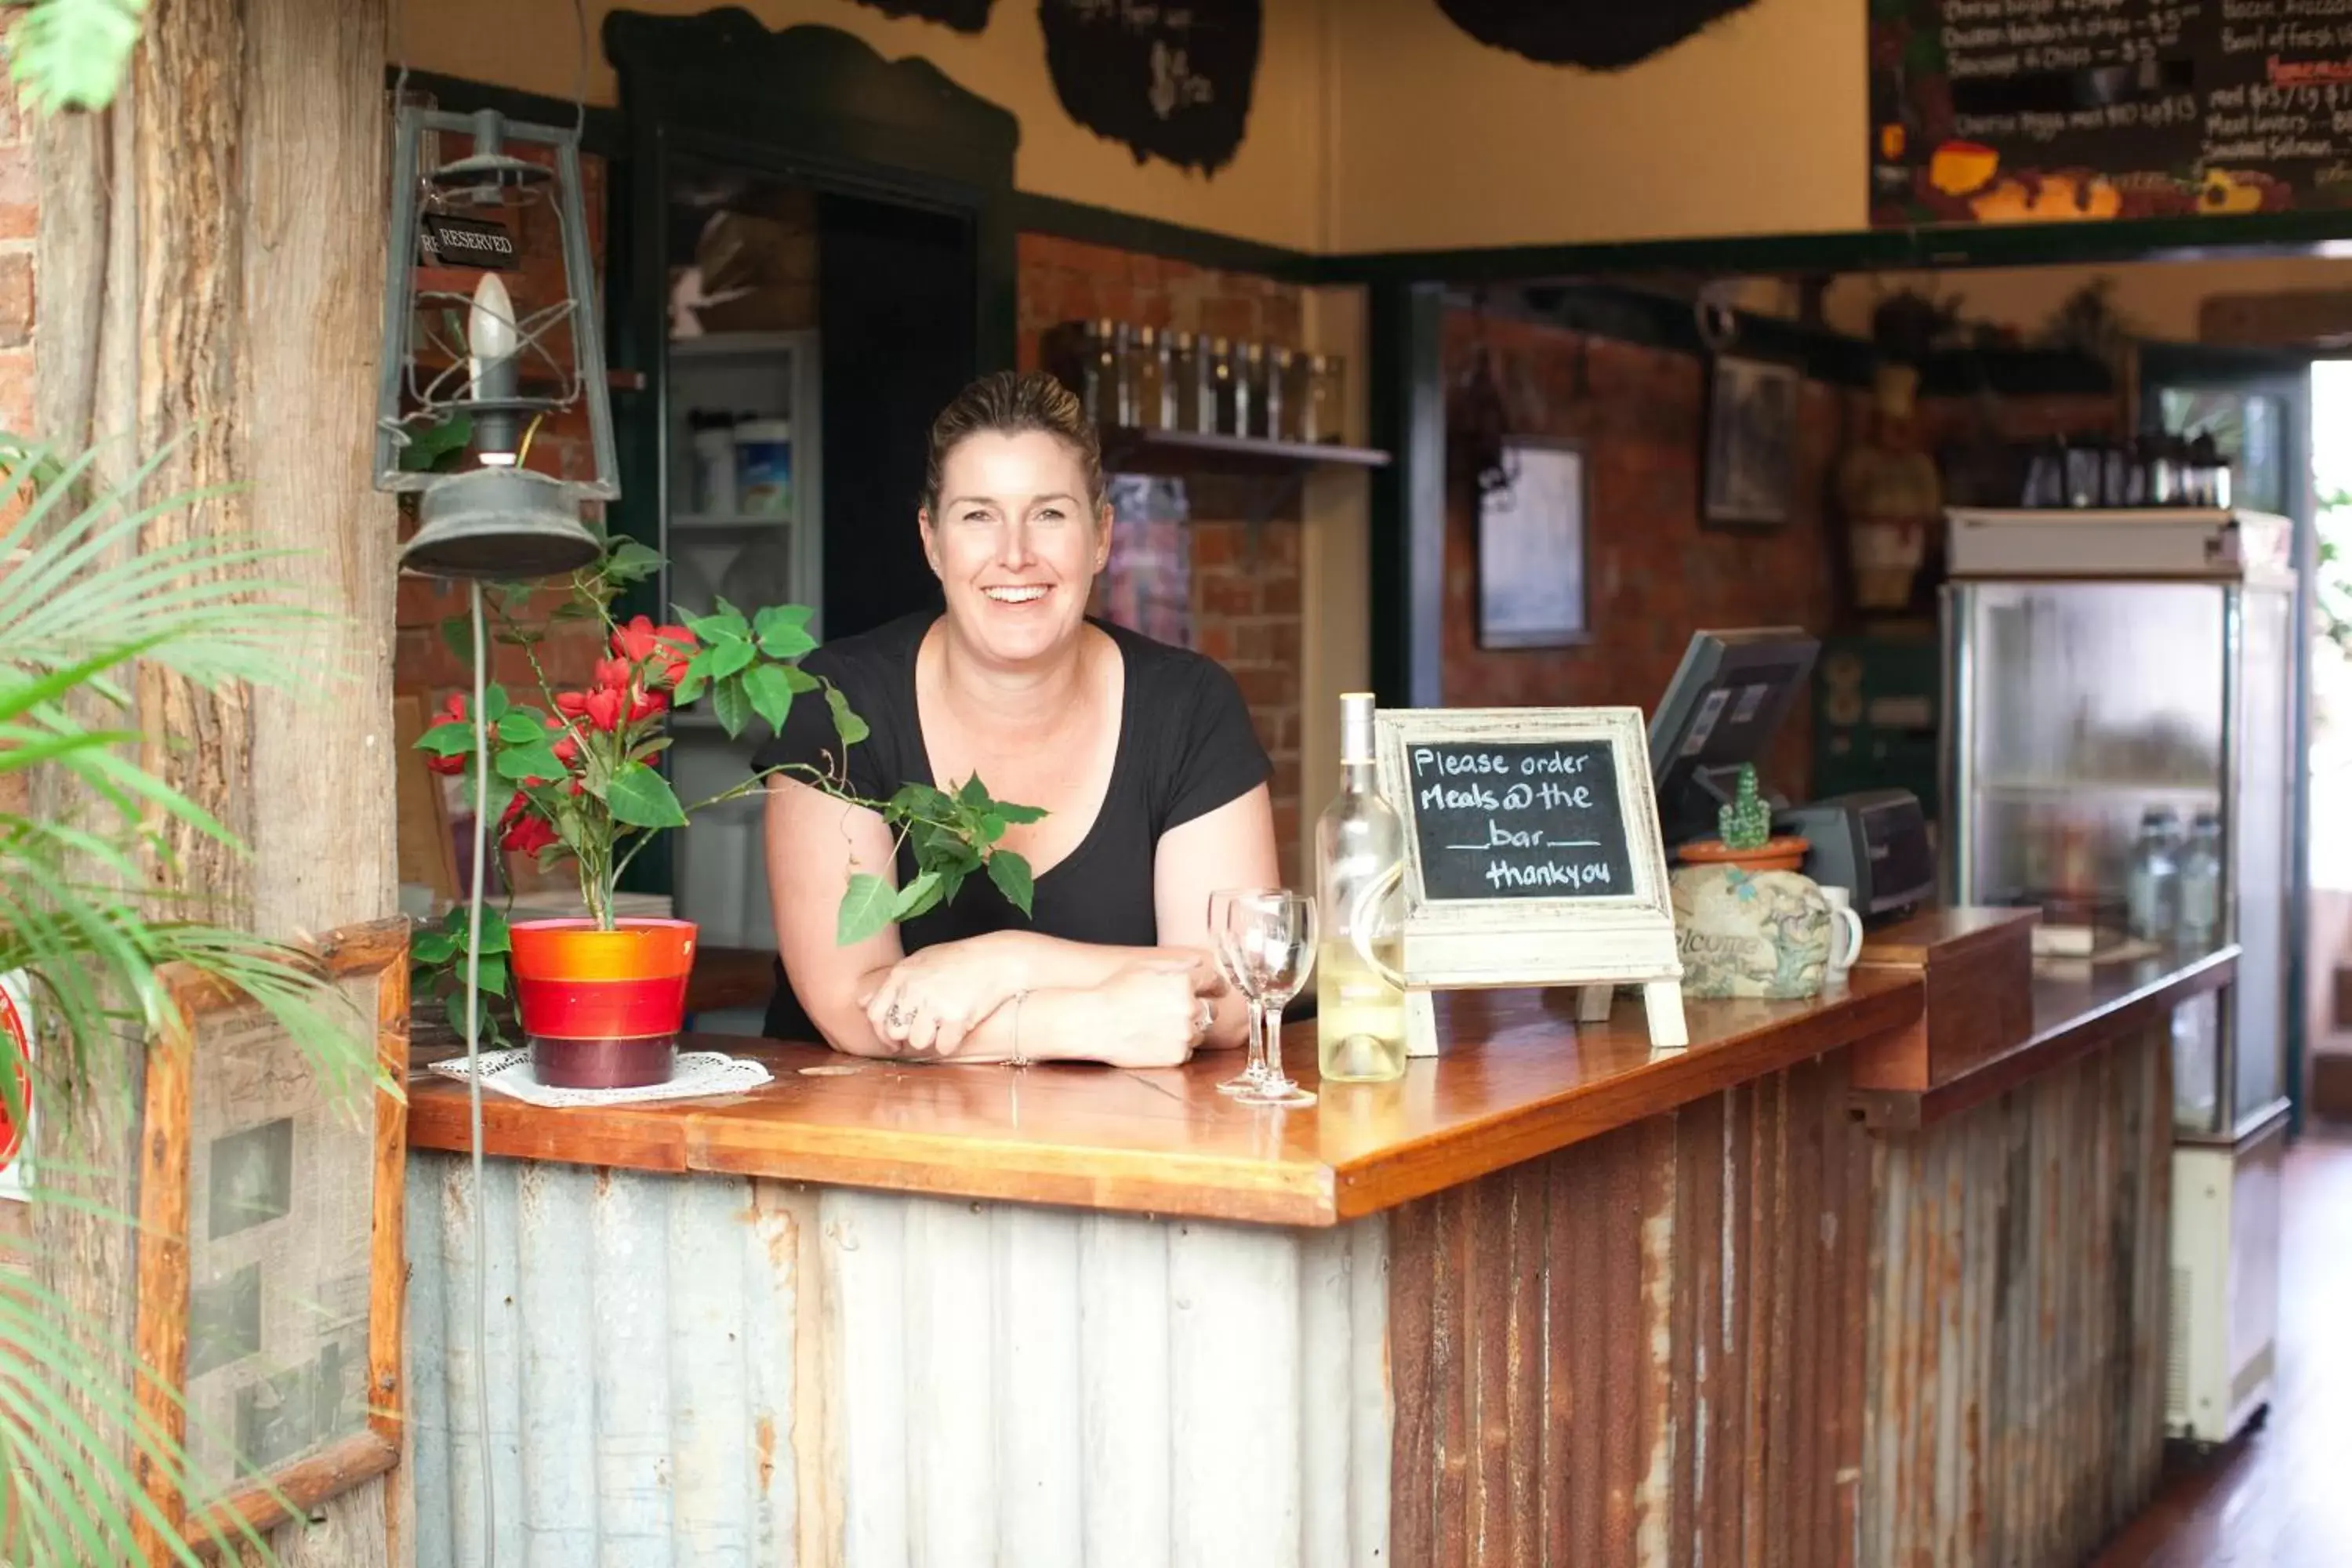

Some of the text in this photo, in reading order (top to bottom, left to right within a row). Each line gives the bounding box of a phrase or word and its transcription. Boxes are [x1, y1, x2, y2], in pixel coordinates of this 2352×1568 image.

[438, 228, 512, 253] RESERVED
[1414, 749, 1589, 776] Please order
[1489, 818, 1543, 848] bar
[1485, 859, 1611, 890] thankyou
[1675, 928, 1759, 954] lcome
